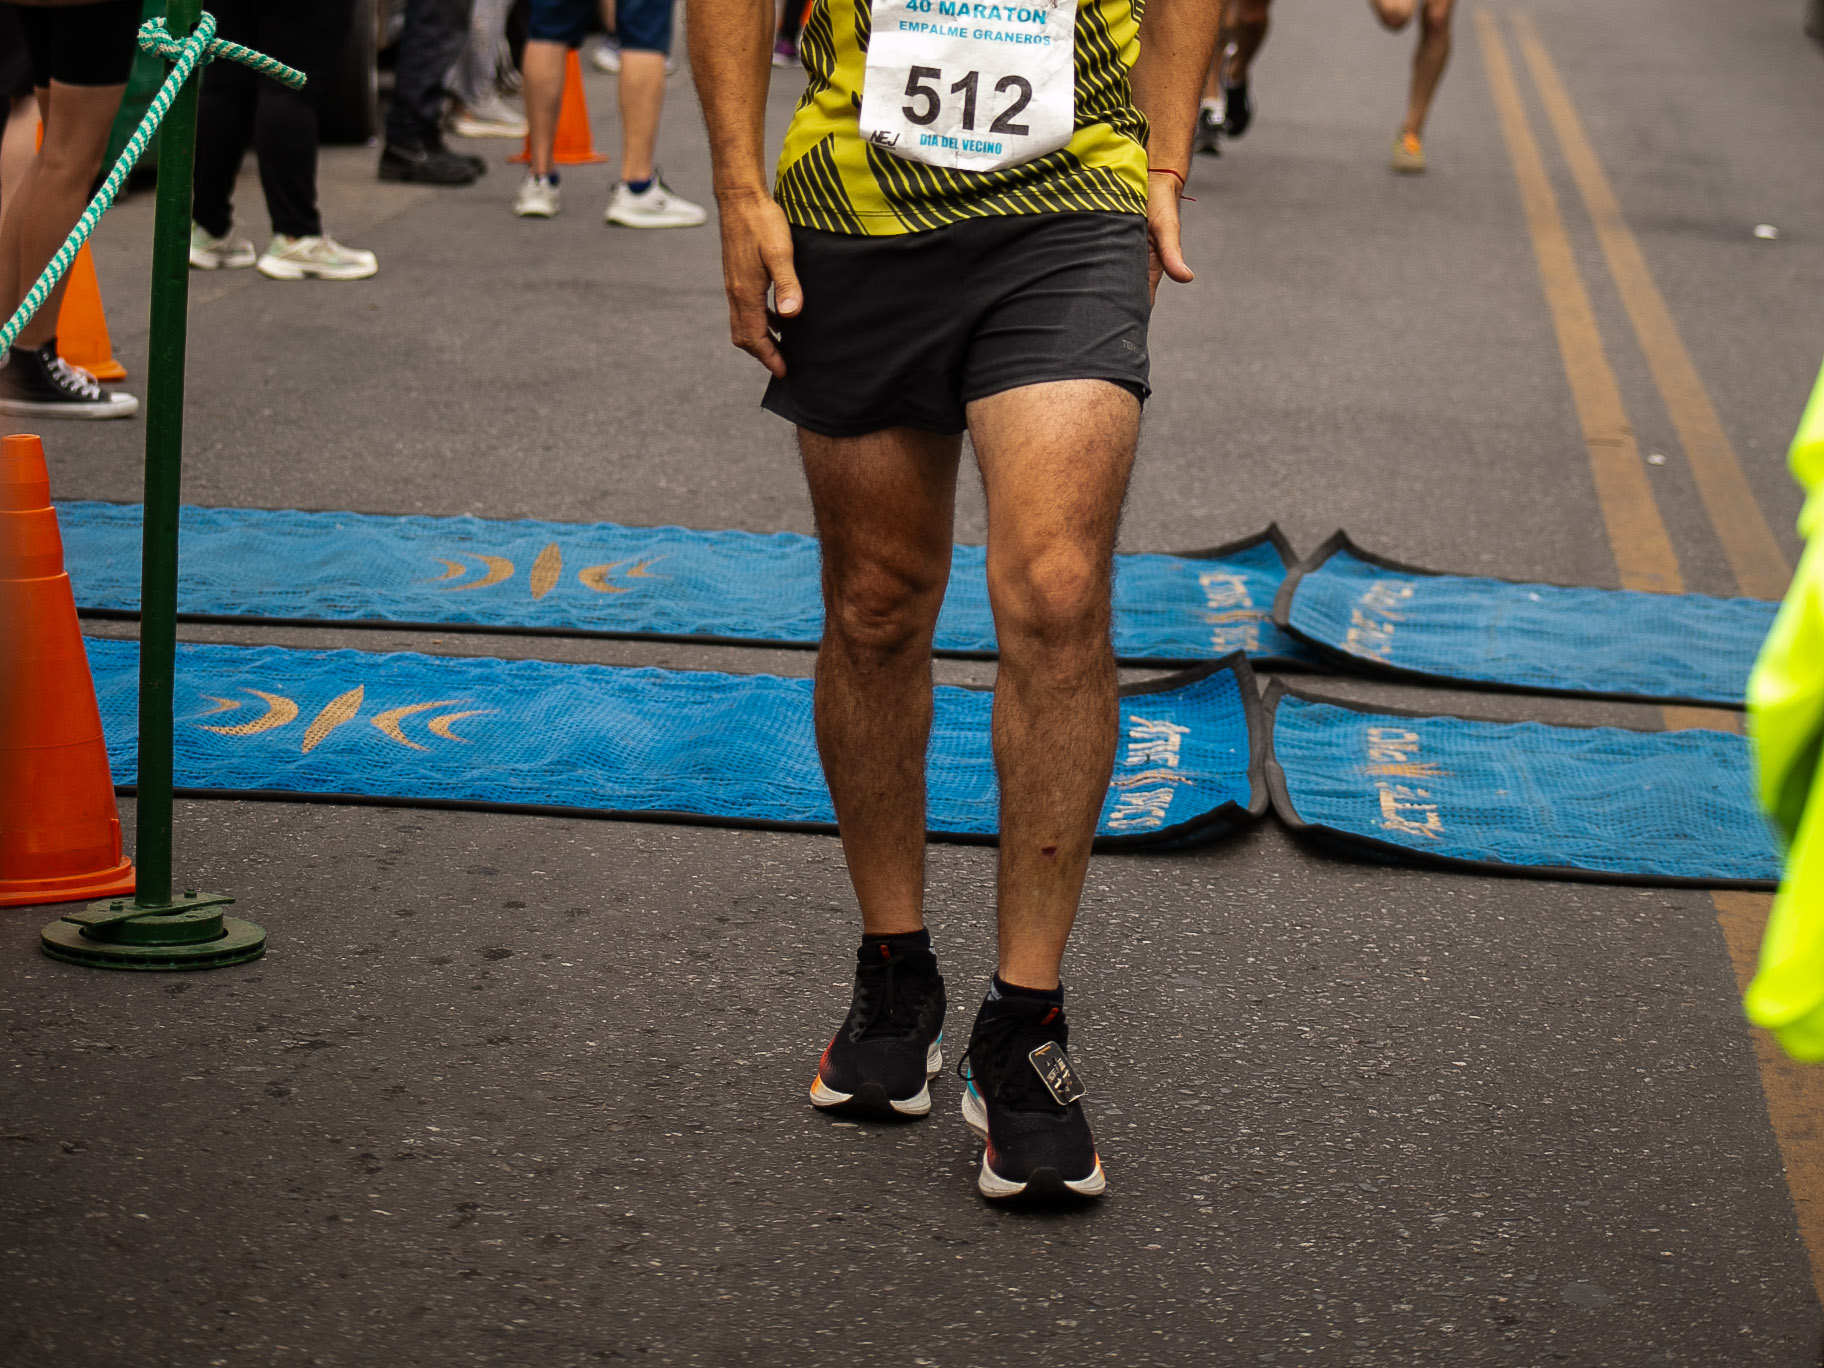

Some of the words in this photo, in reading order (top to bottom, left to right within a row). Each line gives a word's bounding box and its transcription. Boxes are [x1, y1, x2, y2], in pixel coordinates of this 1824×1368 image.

[939, 0, 1047, 25] MARATON
[899, 20, 968, 38] EMPALME
[973, 29, 1051, 46] GRANEROS
[901, 65, 1033, 136] 512
[941, 136, 959, 149] DEL
[962, 139, 1002, 155] VECINO
